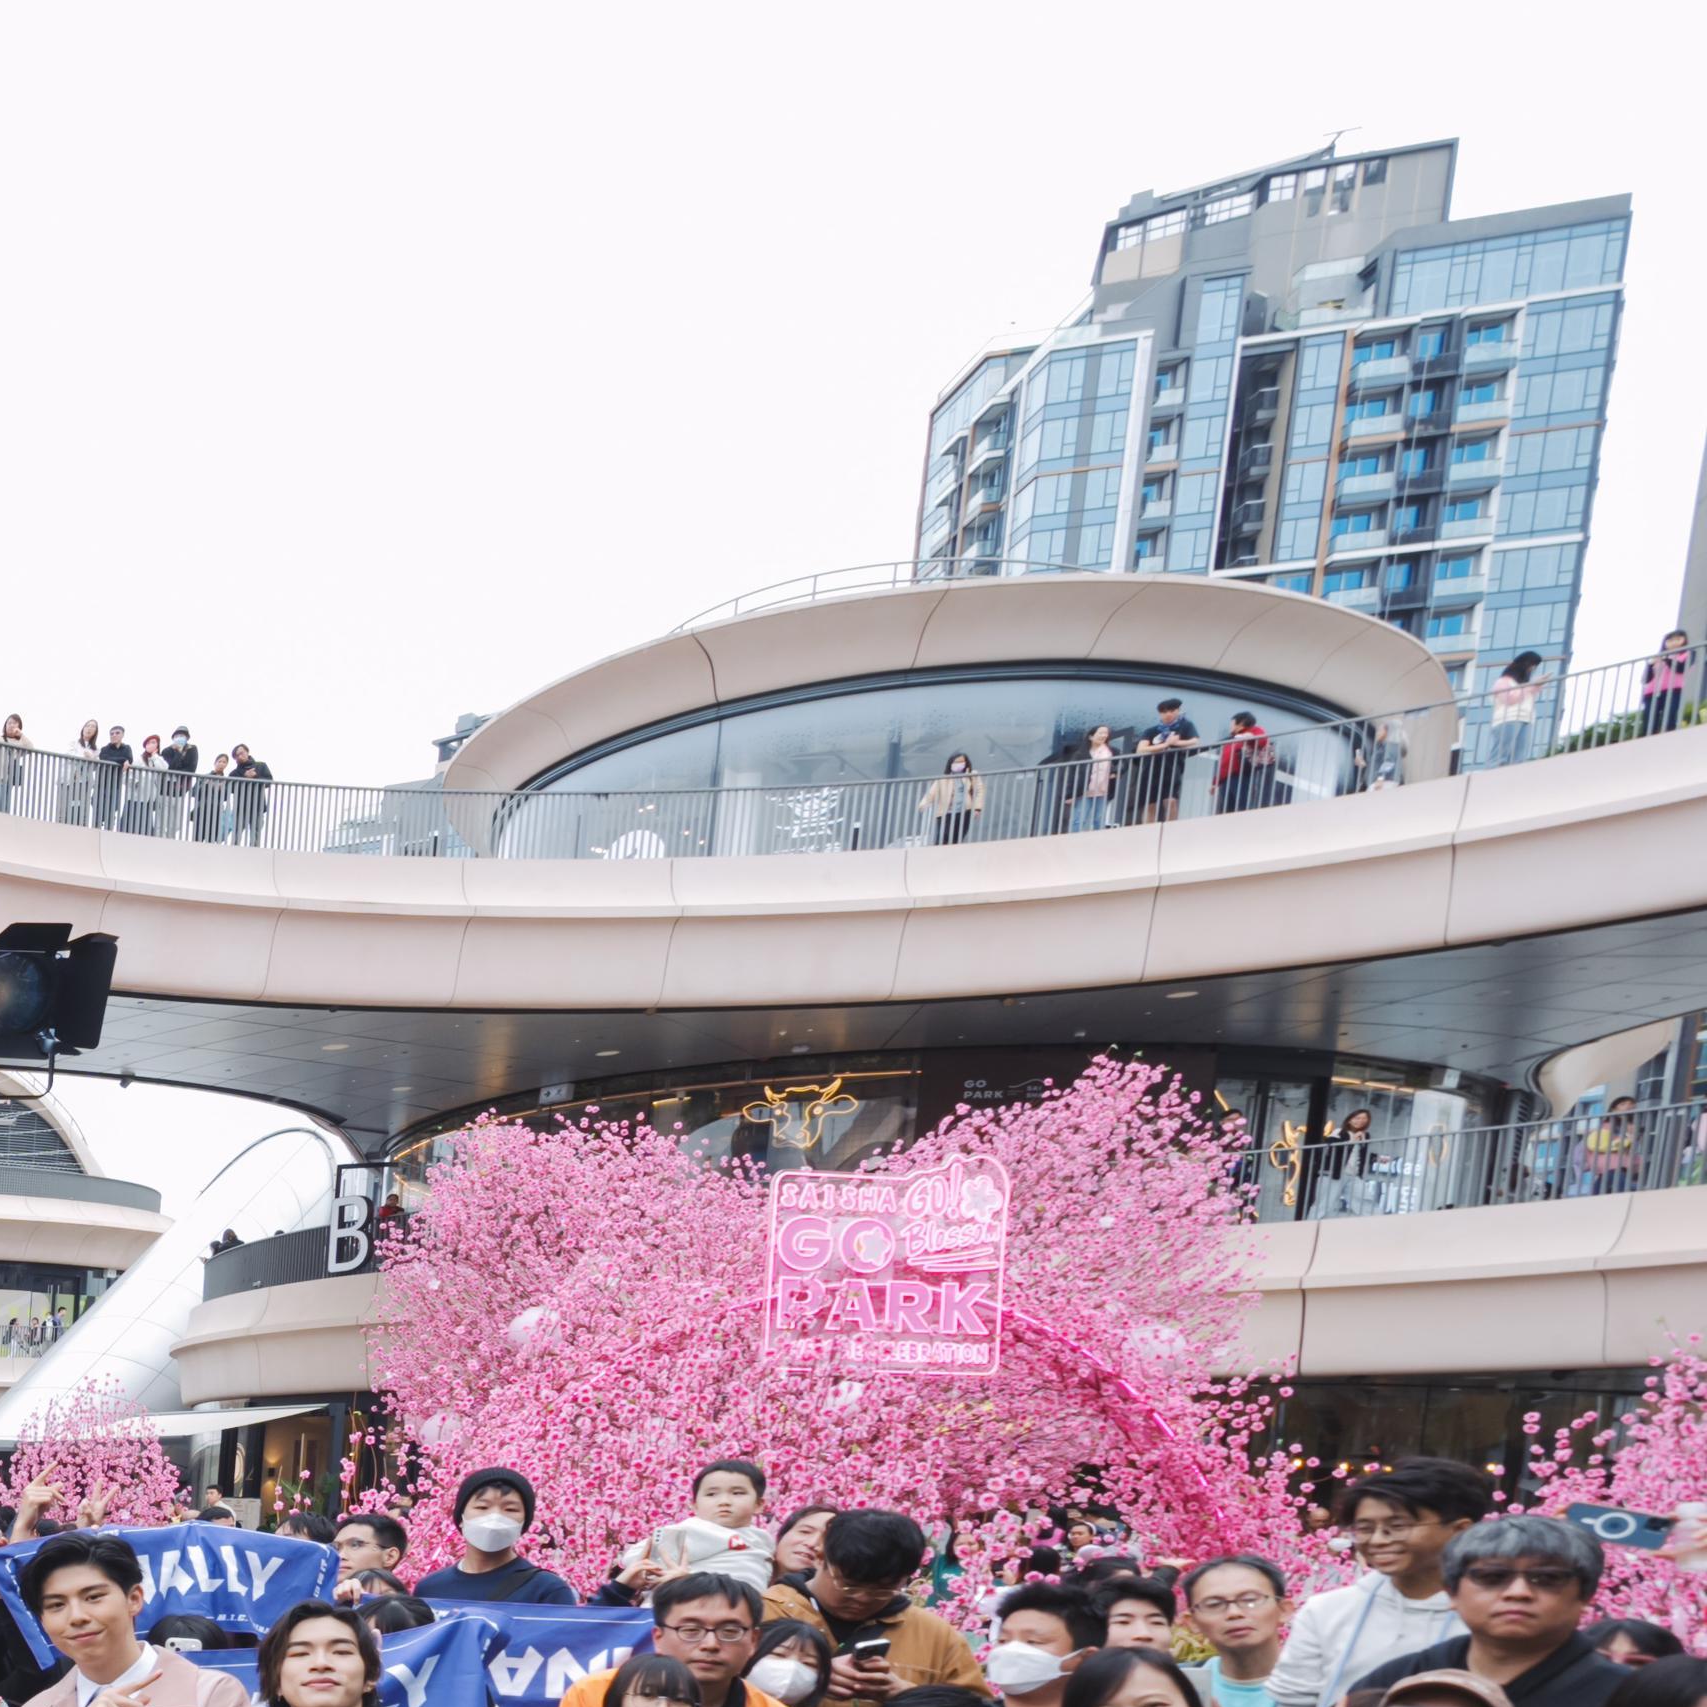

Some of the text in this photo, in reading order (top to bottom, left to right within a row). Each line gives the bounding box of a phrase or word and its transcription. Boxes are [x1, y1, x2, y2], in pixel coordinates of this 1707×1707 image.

[963, 1091, 1004, 1099] PARK
[328, 1195, 368, 1273] B
[778, 1214, 896, 1273] GO
[775, 1276, 991, 1335] PARK
